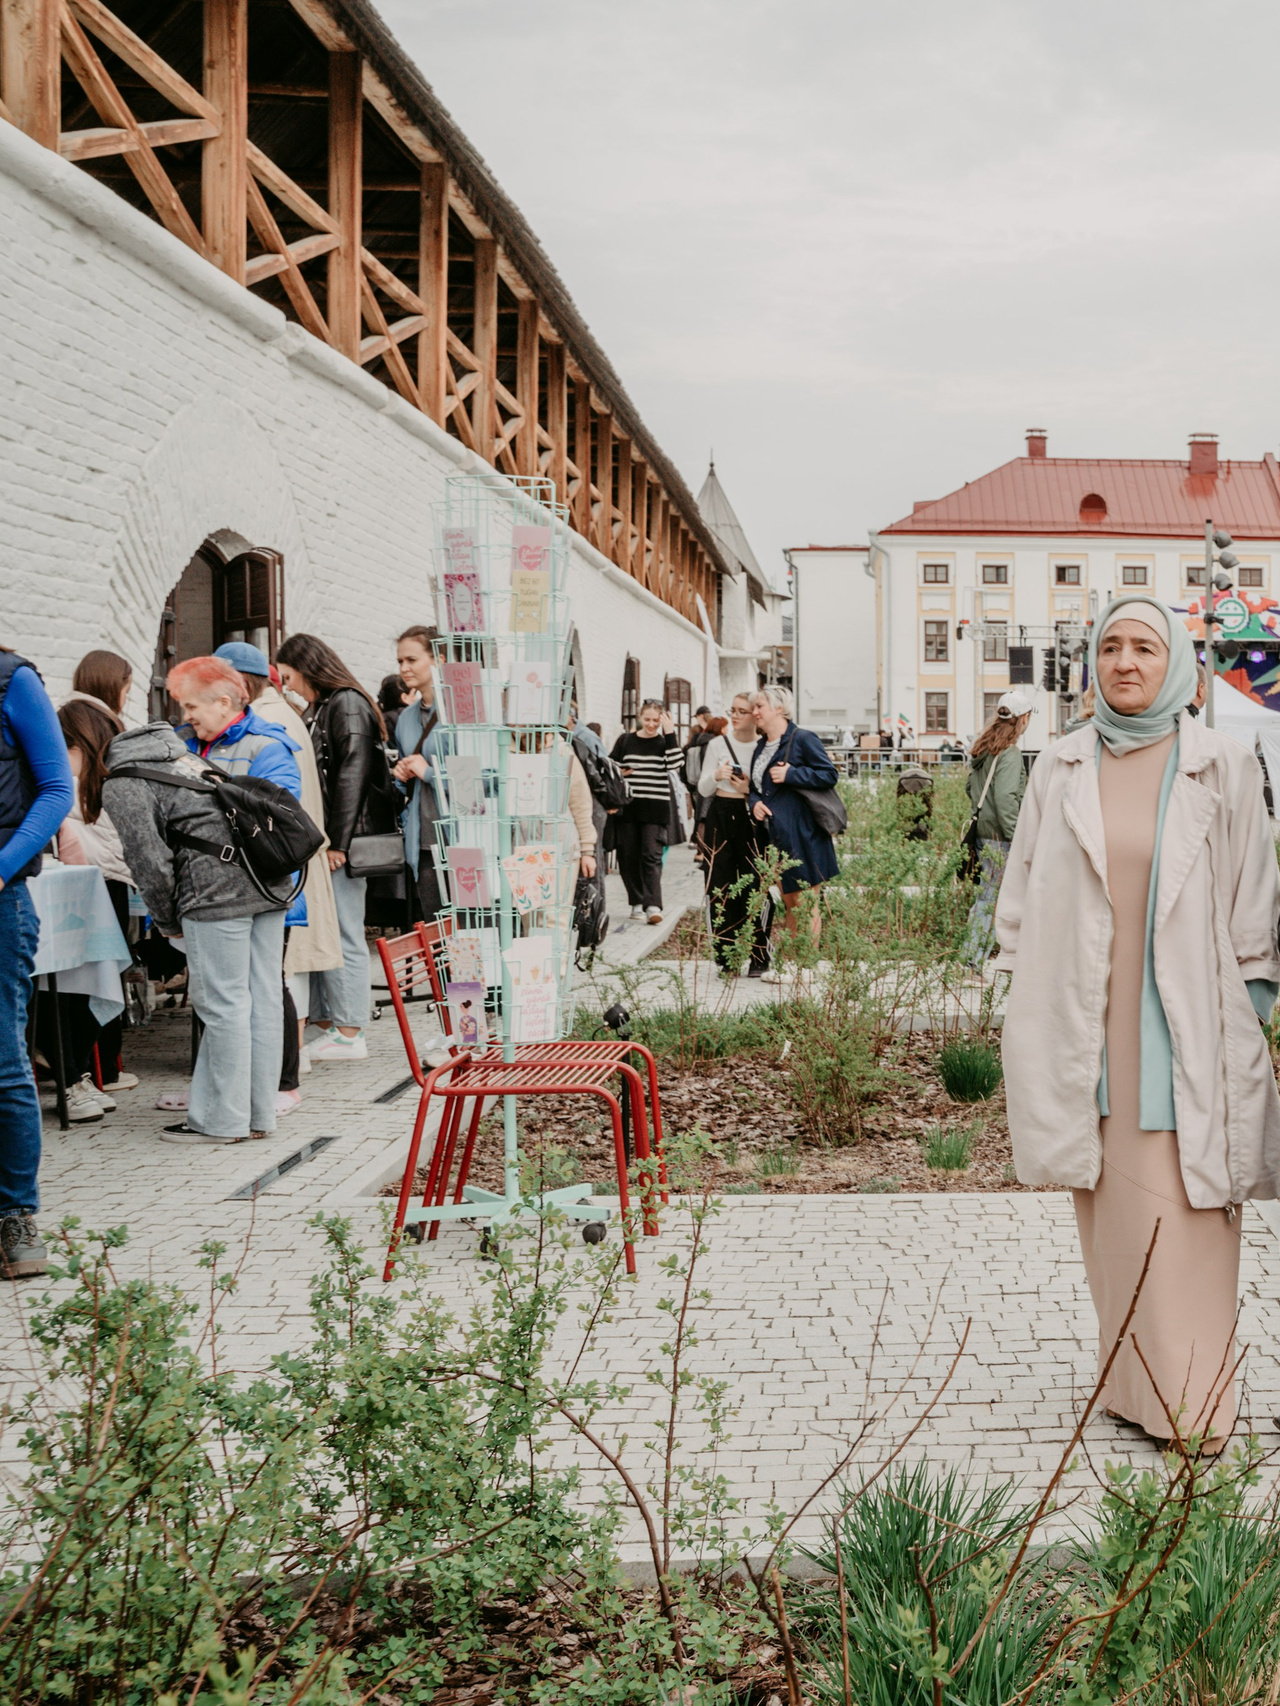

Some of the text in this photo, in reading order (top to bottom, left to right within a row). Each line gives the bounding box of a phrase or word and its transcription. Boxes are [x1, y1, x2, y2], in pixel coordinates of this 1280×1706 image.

[452, 666, 472, 682] gel
[454, 683, 474, 698] gel
[456, 700, 476, 715] gel
